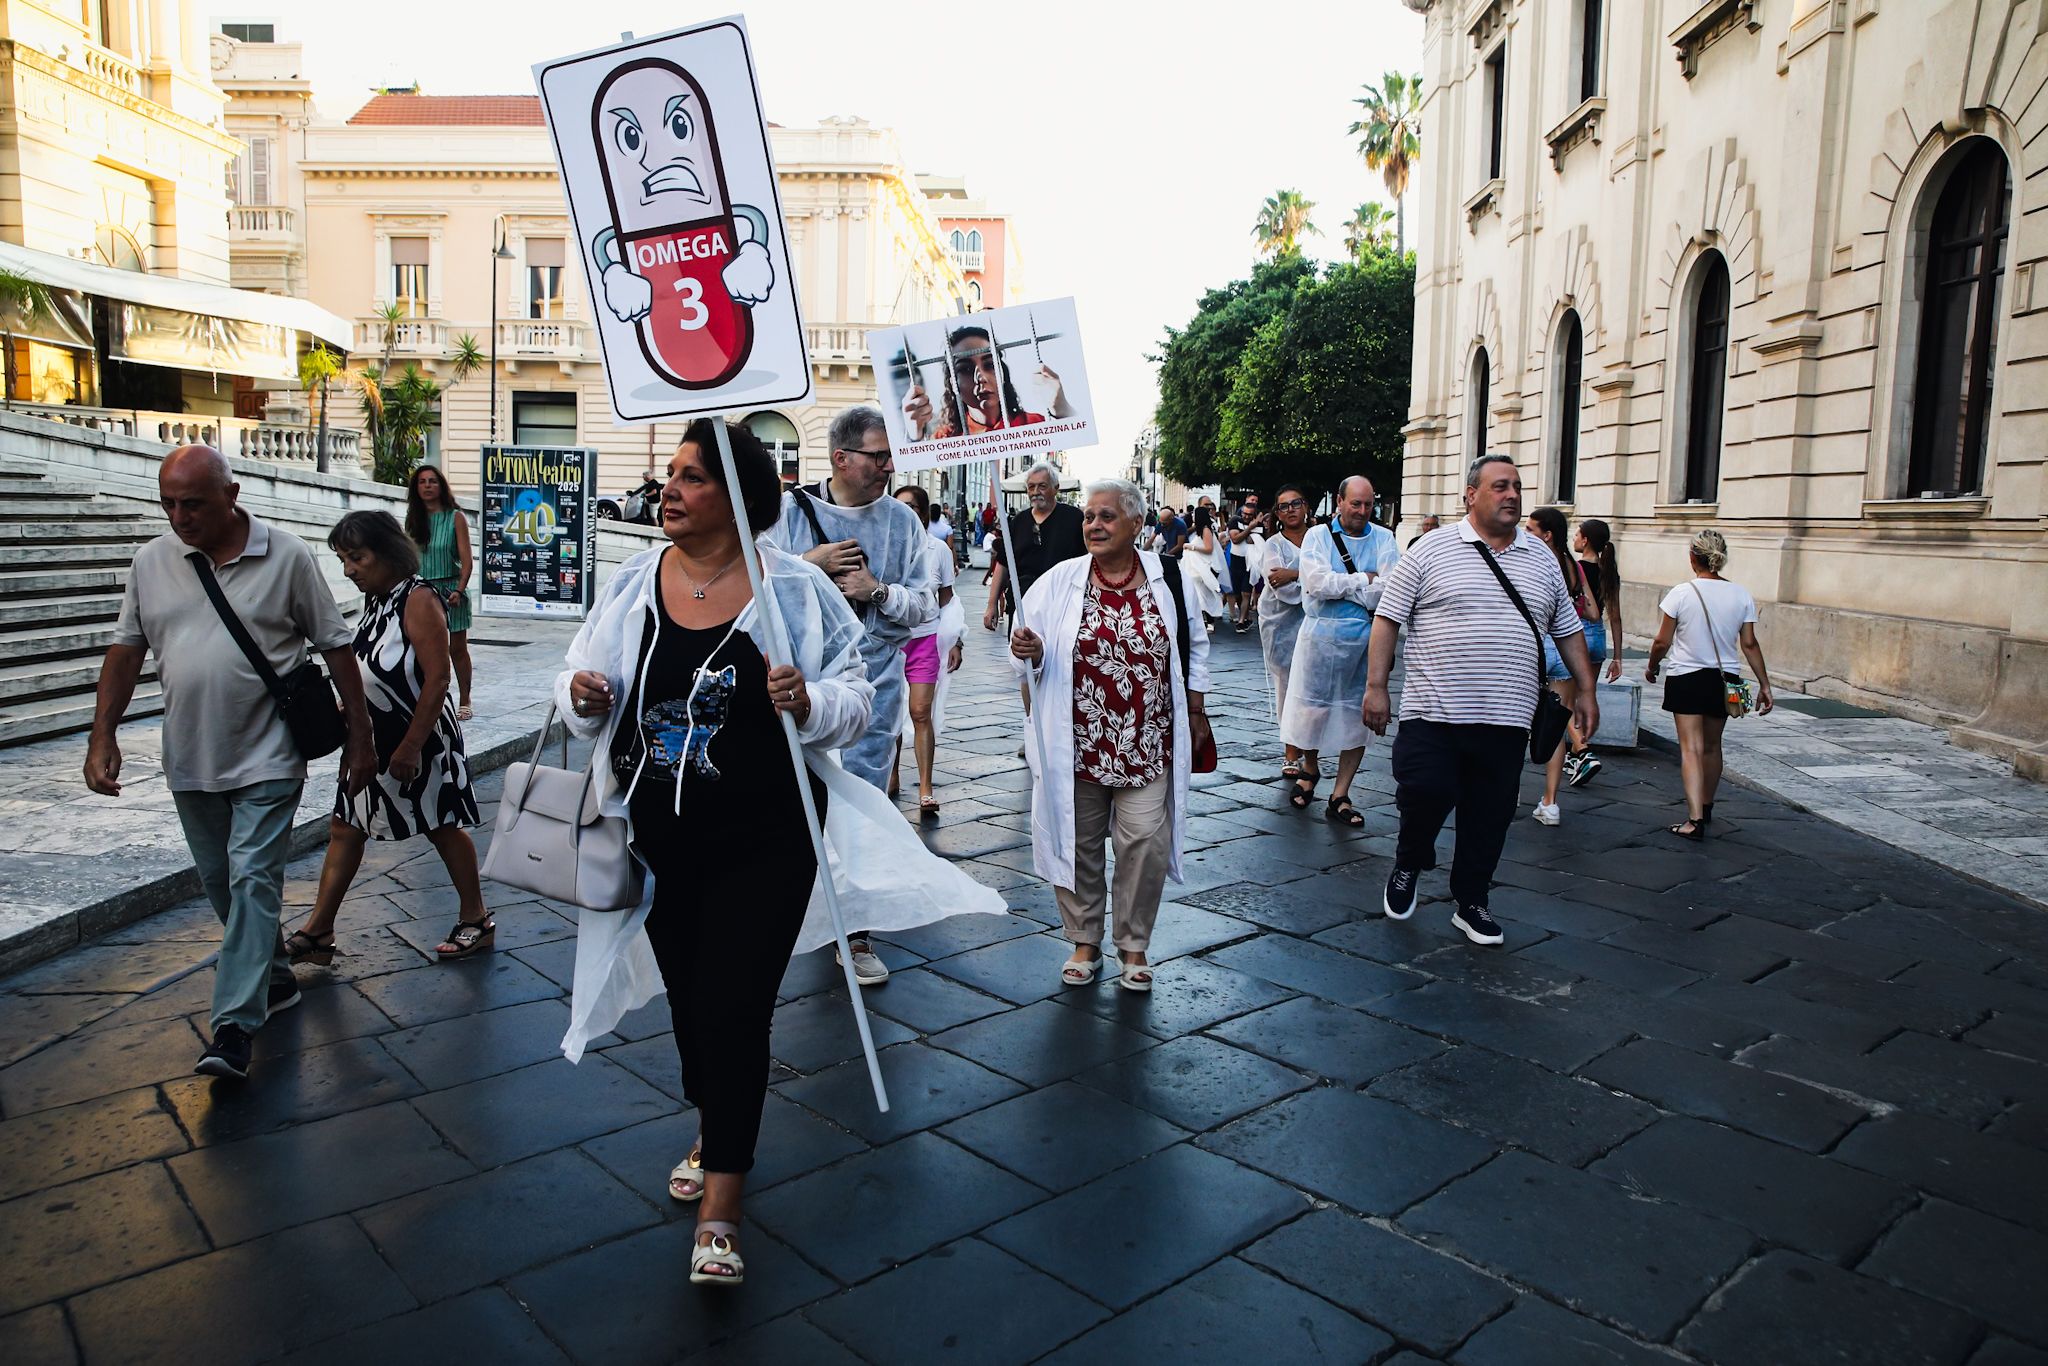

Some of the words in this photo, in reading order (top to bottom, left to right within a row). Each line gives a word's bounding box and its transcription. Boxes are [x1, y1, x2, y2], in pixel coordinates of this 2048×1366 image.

[638, 232, 729, 268] OMEGA
[673, 277, 709, 330] 3
[910, 444, 935, 454] SENTO
[936, 440, 966, 450] CHIUSA
[968, 434, 1001, 446] DENTRO
[1003, 433, 1021, 441] UNA
[1022, 424, 1070, 437] PALAZZINA
[1071, 421, 1087, 430] LAF
[936, 451, 962, 462] (COME
[999, 444, 1008, 453] DI
[1009, 438, 1051, 451] TARANTO)
[557, 481, 579, 492] 2025
[504, 503, 556, 546] 40
